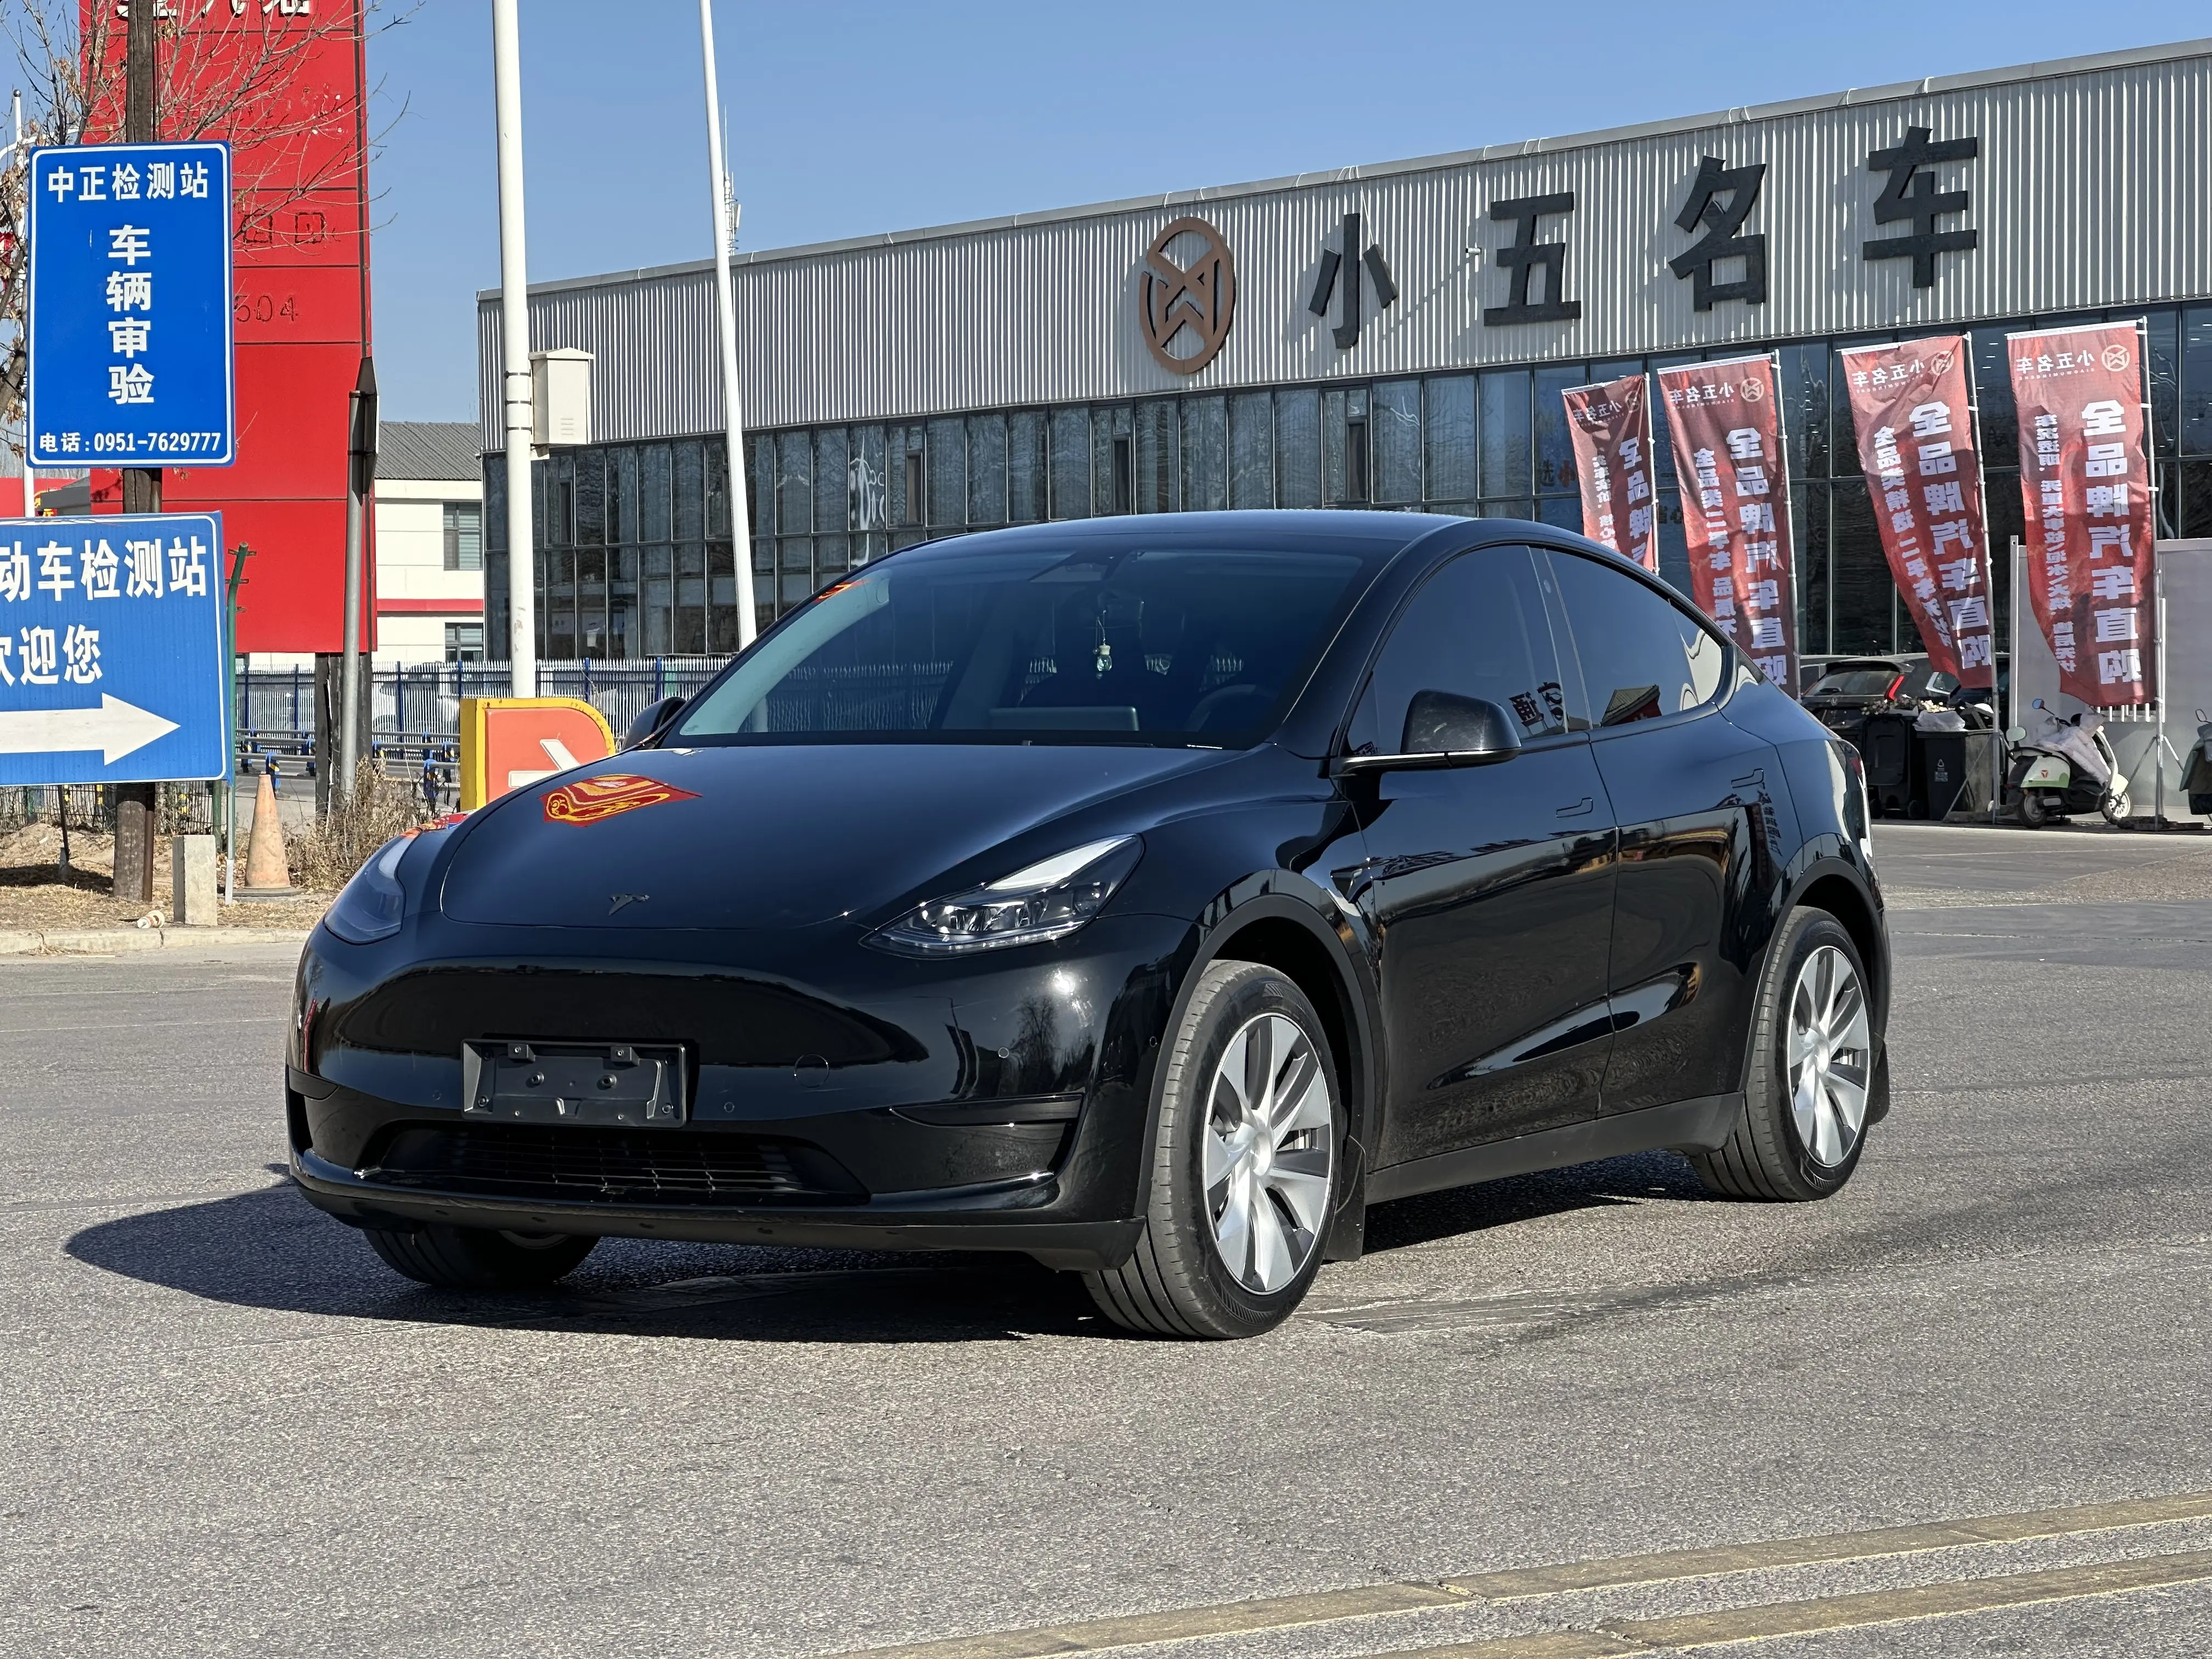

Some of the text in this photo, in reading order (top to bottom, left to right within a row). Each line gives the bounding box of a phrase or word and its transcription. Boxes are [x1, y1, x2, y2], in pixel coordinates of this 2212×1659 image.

[48, 161, 209, 204] 中正检测站
[1308, 126, 1979, 350] 小五名车
[106, 224, 154, 405] 车辆审验
